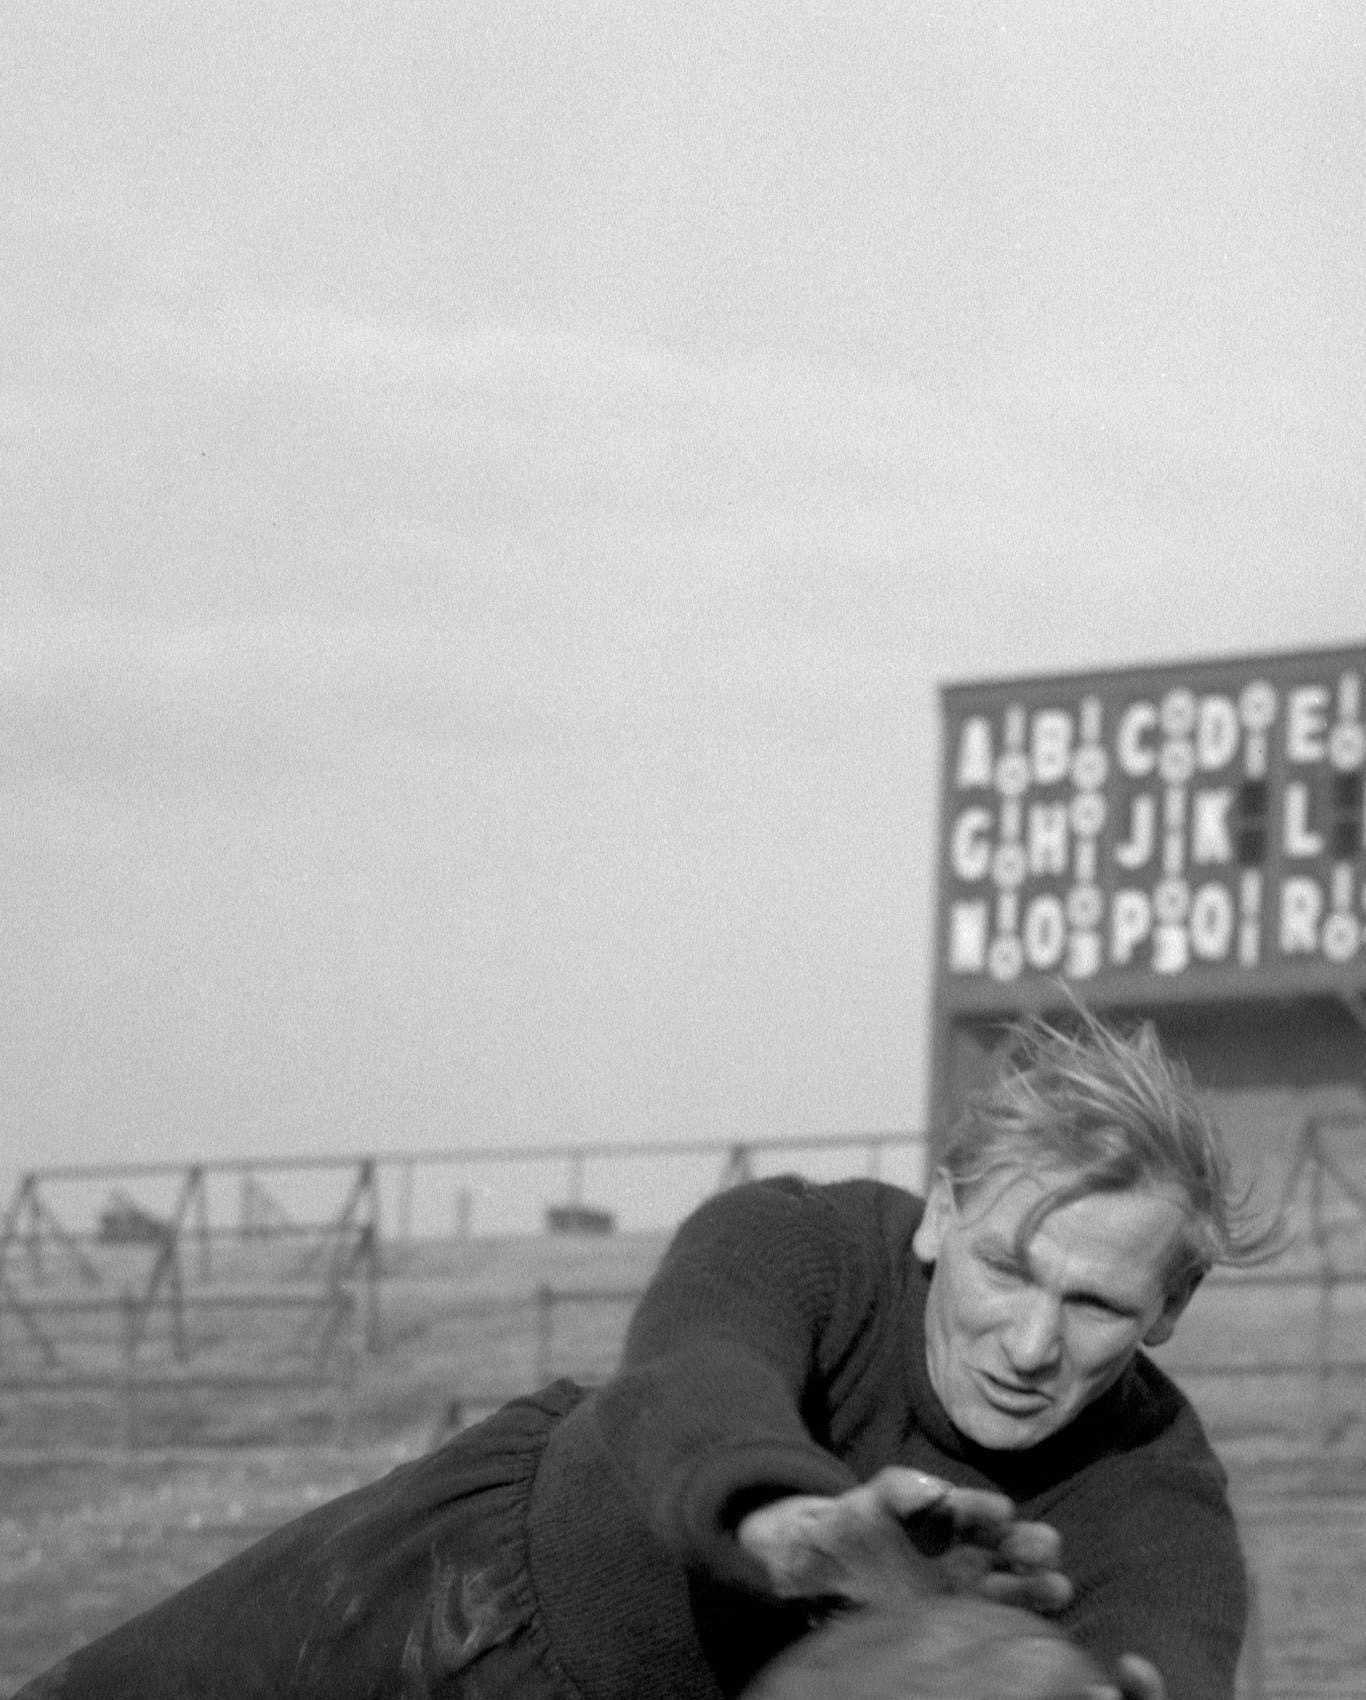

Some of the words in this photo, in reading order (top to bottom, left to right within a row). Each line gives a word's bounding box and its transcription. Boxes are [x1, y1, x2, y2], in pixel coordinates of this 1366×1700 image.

[956, 716, 993, 790] A
[1031, 708, 1074, 783] B
[1117, 701, 1157, 777] C
[1285, 685, 1331, 764] E
[951, 807, 992, 881] G
[1028, 803, 1068, 876] H
[1115, 794, 1154, 869] J
[1192, 788, 1232, 864] K
[1284, 782, 1324, 858] L
[1024, 894, 1064, 970] O
[1111, 889, 1152, 965] P
[1280, 877, 1324, 955] R
